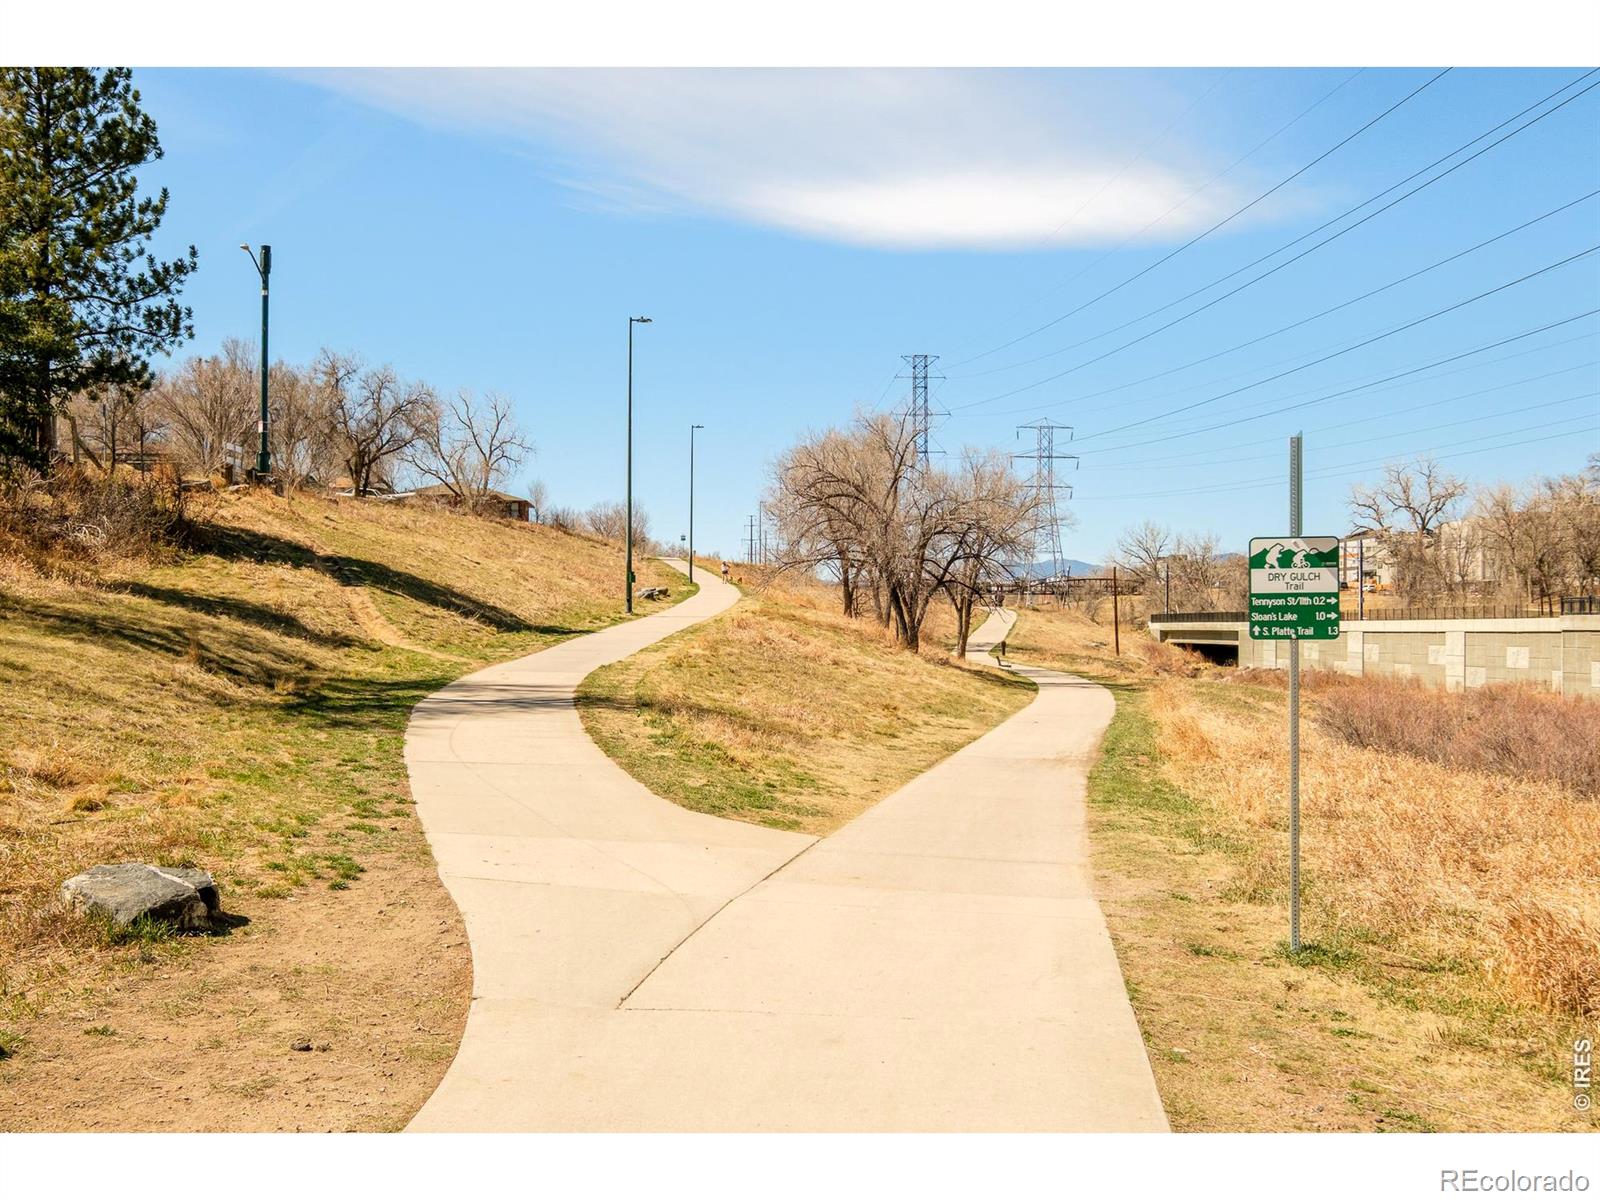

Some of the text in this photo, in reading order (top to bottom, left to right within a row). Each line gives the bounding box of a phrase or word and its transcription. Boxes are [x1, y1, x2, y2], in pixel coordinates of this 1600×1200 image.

[1268, 572, 1320, 581] DRY GULCH
[1285, 582, 1304, 591] Trail
[1251, 597, 1285, 608] Tennyson
[1251, 612, 1277, 621] Sloan's
[1279, 612, 1297, 621] Lake
[1262, 627, 1270, 636] S.
[1271, 626, 1295, 636] Platte
[1297, 626, 1314, 635] Trail
